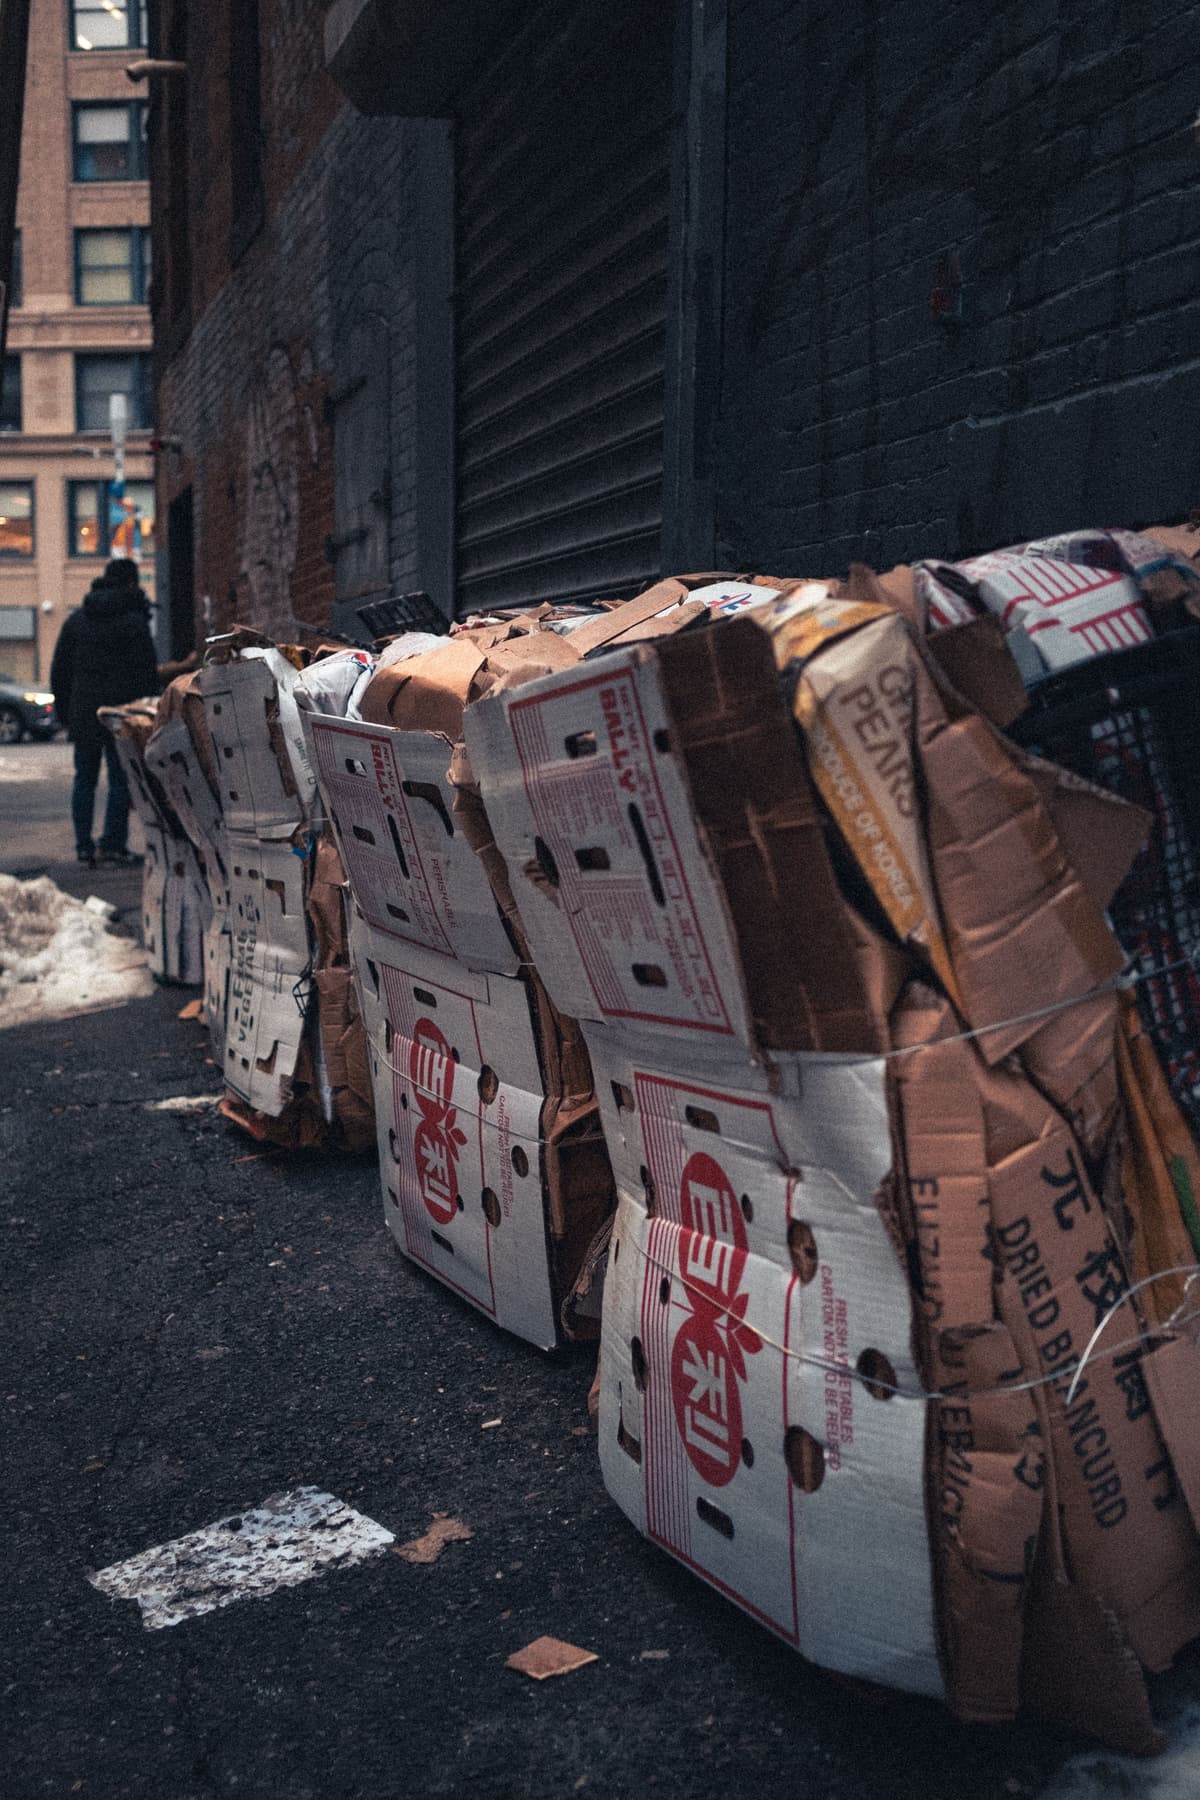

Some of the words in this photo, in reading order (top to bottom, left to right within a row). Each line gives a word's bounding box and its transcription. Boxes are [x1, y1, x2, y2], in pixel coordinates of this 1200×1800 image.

[600, 687, 637, 791] BALLY
[839, 684, 914, 818] PEARS
[371, 744, 394, 808] BALLY
[855, 809, 880, 838] OF
[871, 841, 915, 911] KOREA
[432, 859, 456, 928] PERISHABLE
[238, 895, 256, 1041] VEGETABLES
[821, 1265, 833, 1326] CARTON
[836, 1298, 848, 1346] FRESH
[824, 1330, 835, 1361] NOT
[997, 1216, 1060, 1331] DRIED
[1040, 1330, 1129, 1528] BEANCURD
[825, 1389, 834, 1408] BE
[827, 1411, 840, 1471] REUSED
